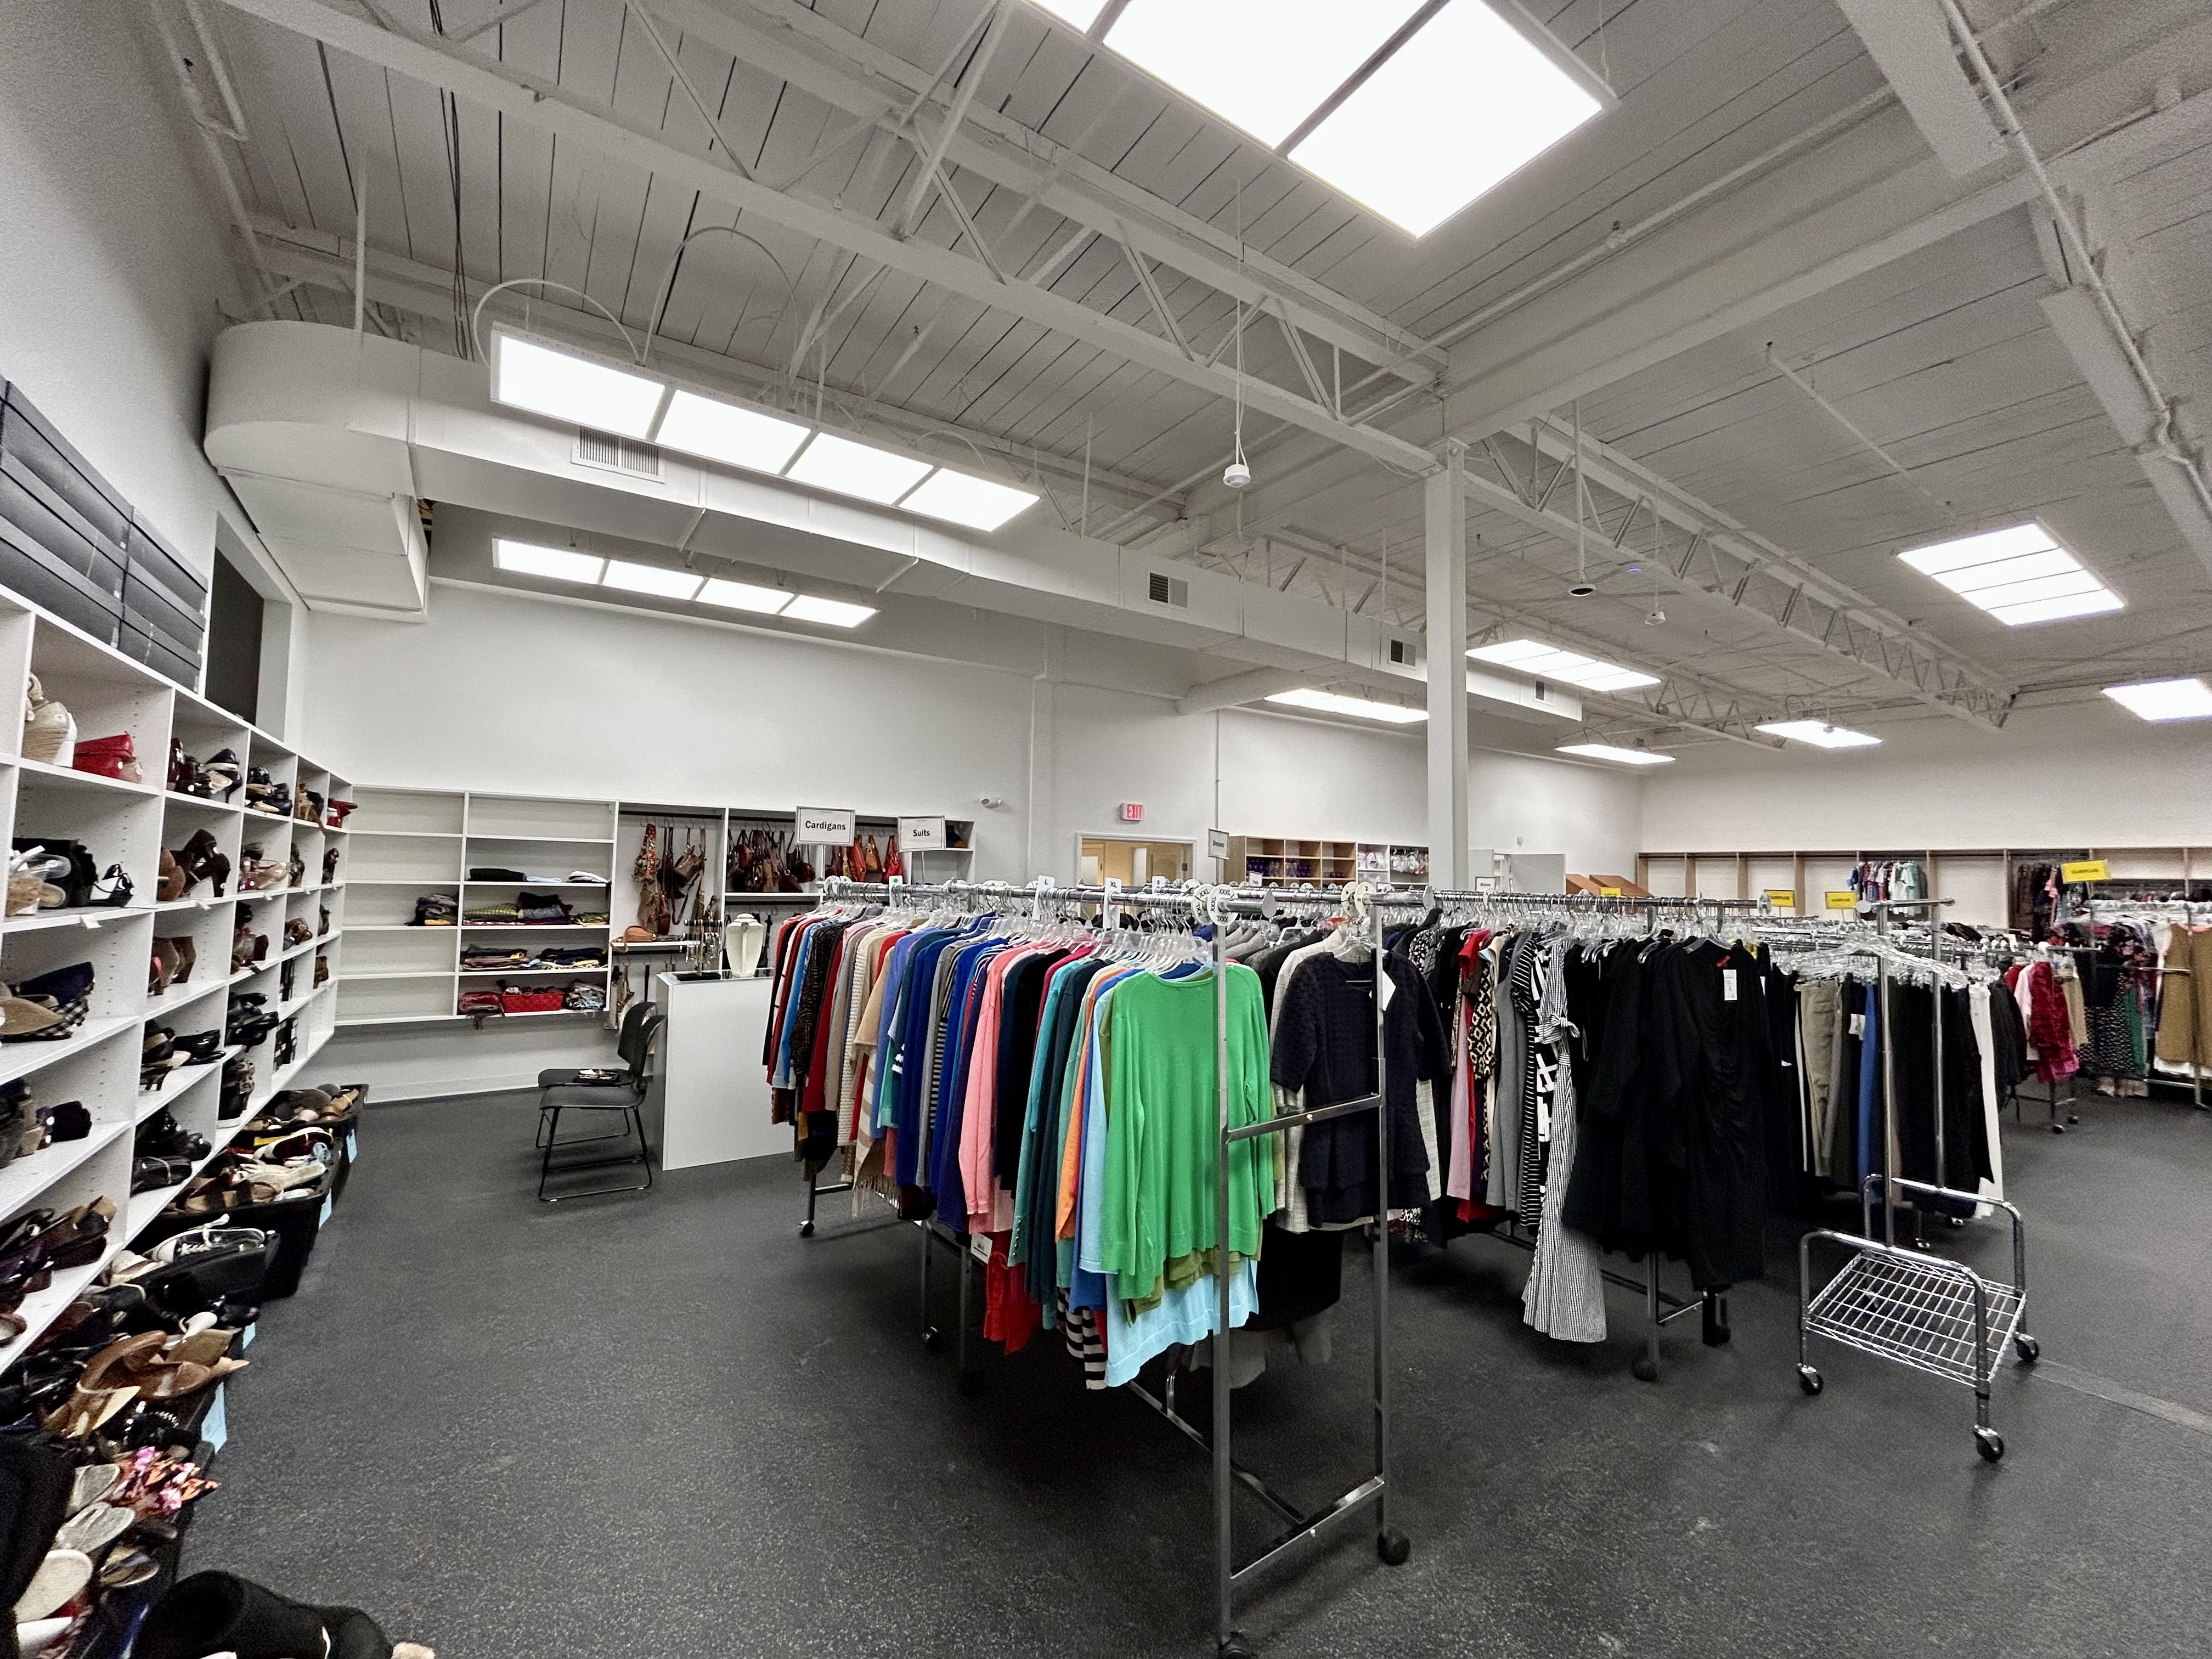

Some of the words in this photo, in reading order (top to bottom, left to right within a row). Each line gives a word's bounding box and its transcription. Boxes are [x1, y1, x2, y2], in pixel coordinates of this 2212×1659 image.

[1127, 804, 1142, 819] EXIT
[805, 820, 846, 831] Cardigans
[1199, 888, 1210, 898] XXL
